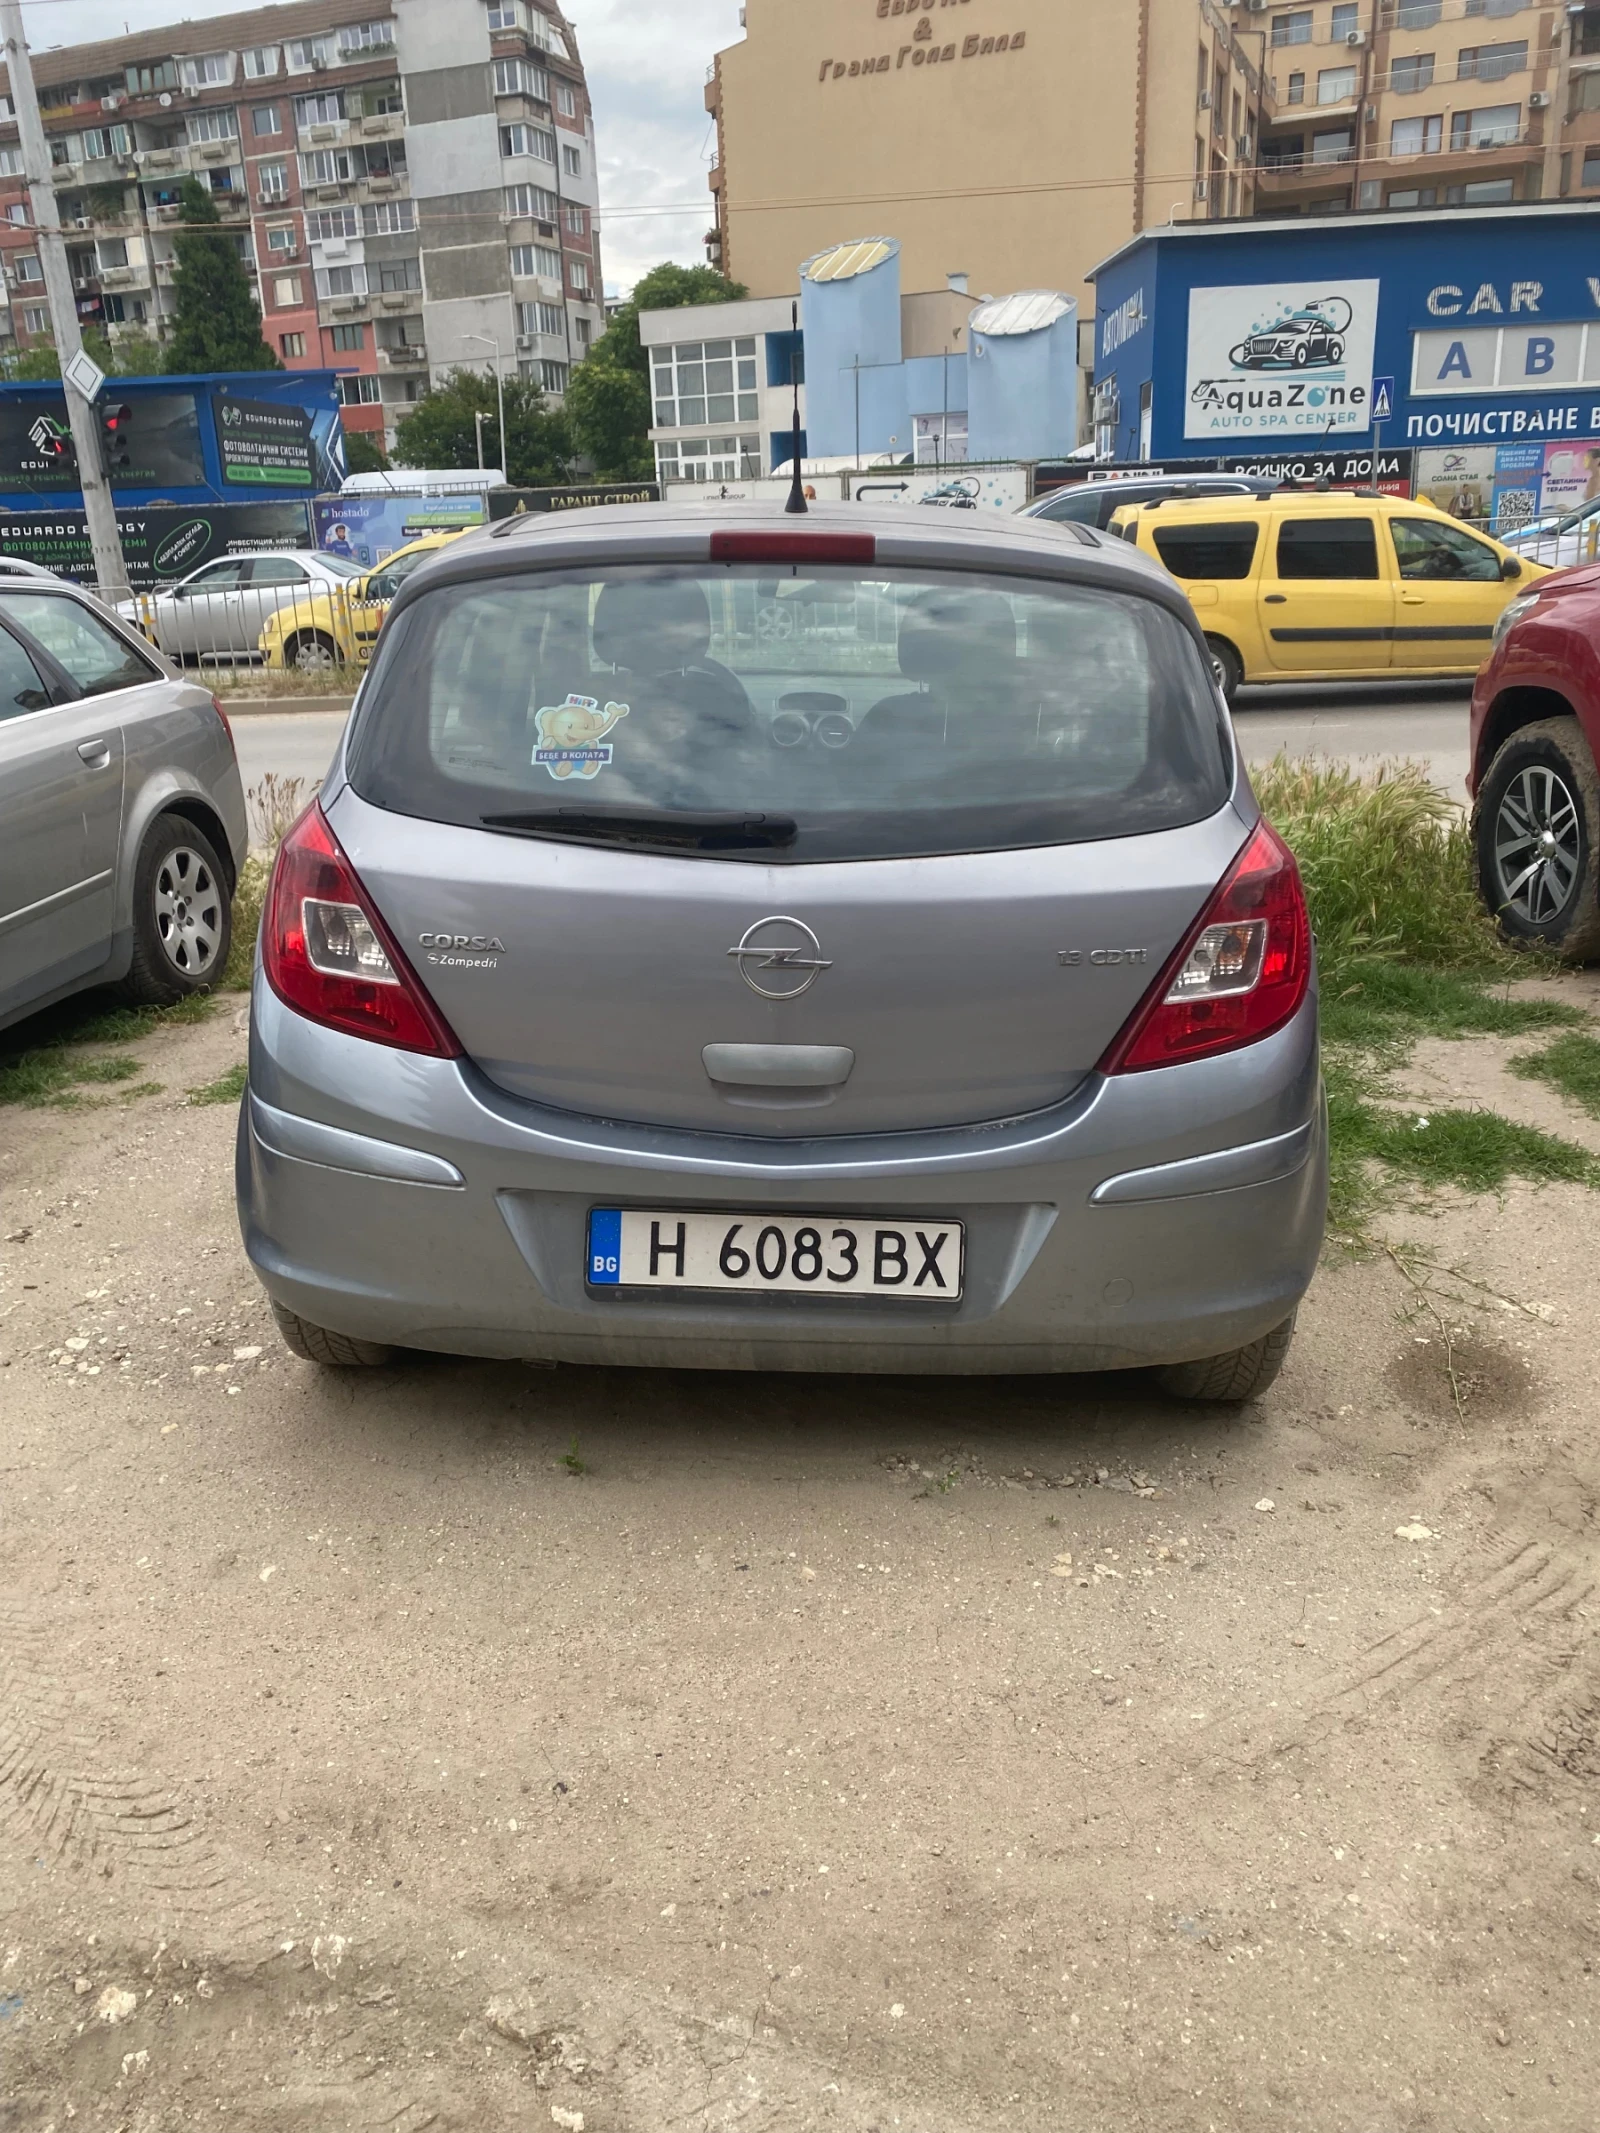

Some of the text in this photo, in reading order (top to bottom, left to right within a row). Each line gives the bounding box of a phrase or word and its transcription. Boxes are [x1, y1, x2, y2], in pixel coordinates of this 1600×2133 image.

[914, 17, 932, 41] &
[819, 31, 1026, 82] Гранд Голд Билд
[1427, 281, 1544, 316] CAR
[1210, 411, 1357, 428] AUTO SPA CENTER
[1407, 407, 1579, 437] ПОЧИСТВАНЕ
[1235, 457, 1399, 479] ВСИЧКО ЗА ДОМА
[550, 489, 650, 509] ГАРАНТ СТРОЙ
[1, 525, 76, 537] EDUARDO
[539, 751, 605, 760] БЕБЕ В КОЛАТА
[419, 932, 505, 952] CORSA
[439, 954, 498, 969] Zampedri
[594, 1255, 618, 1273] BG
[649, 1221, 949, 1288] H 6083 BX
